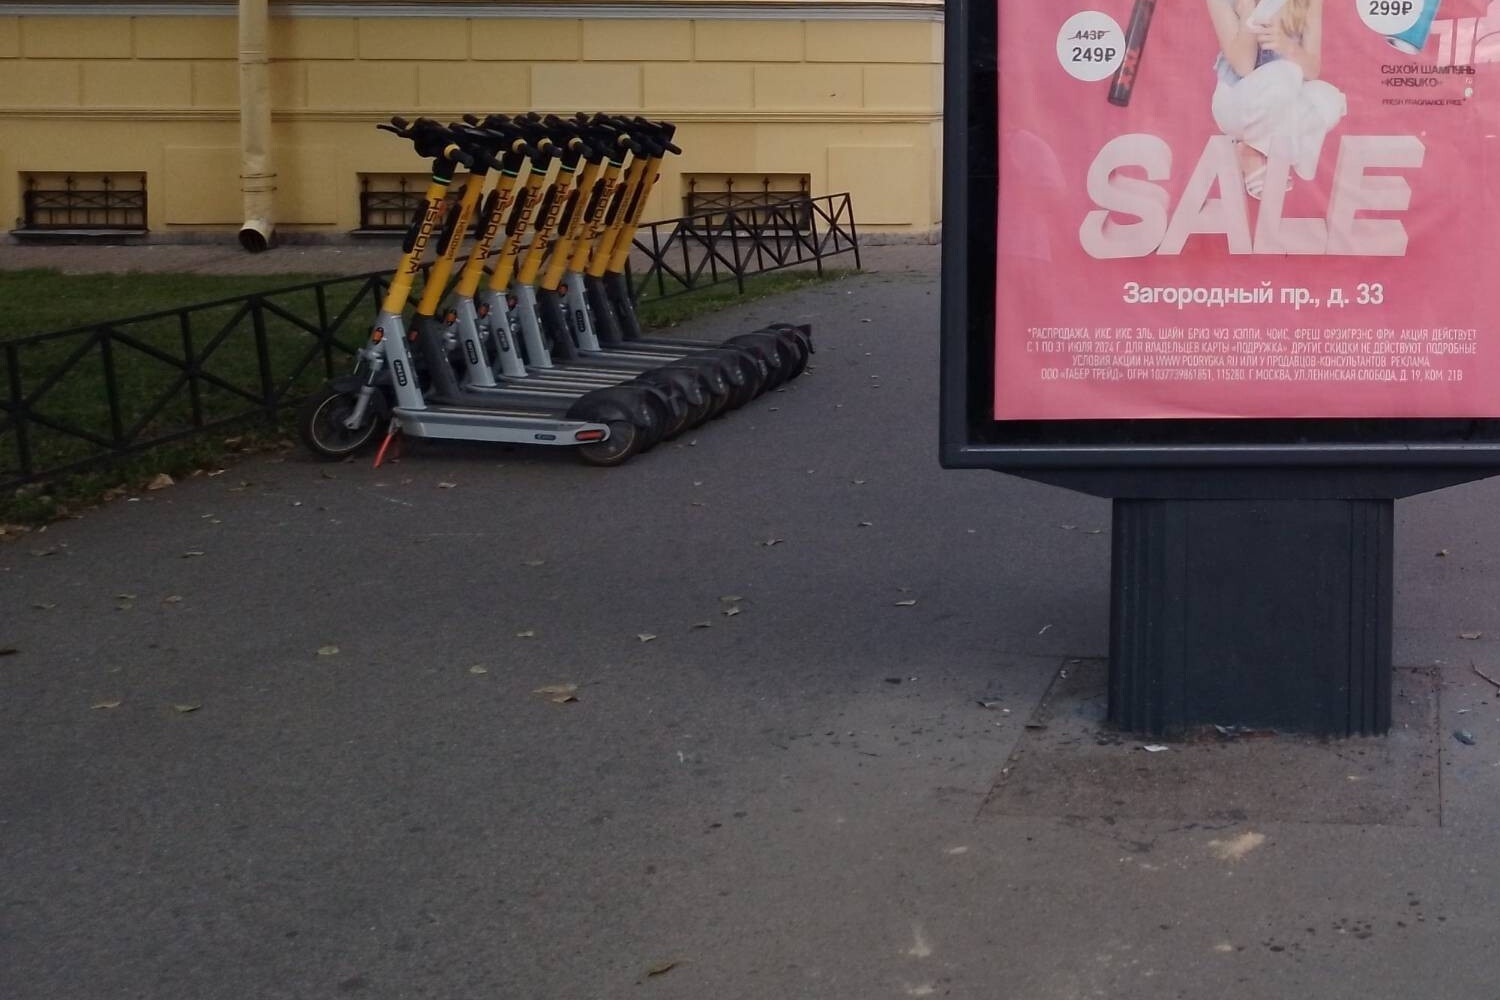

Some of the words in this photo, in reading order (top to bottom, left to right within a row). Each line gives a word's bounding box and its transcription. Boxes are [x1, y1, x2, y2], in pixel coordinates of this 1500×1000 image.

[1381, 62, 1419, 74] СУХОЙ
[1421, 65, 1476, 75] ШАМПУНЬ
[1079, 133, 1425, 259] SALE
[474, 188, 513, 261] WHOOSH
[506, 186, 543, 257] WHOOSH
[534, 183, 571, 251] WHOOSH
[404, 197, 443, 275] WHOOSH
[1122, 280, 1273, 309] Загородный
[1280, 285, 1320, 310] пр.,
[1327, 286, 1349, 306] д.
[1356, 283, 1384, 305] 33
[1041, 341, 1054, 353] ПО
[1068, 341, 1093, 353] ИЮЛЯ
[1125, 341, 1144, 353] ДЛЯ
[1145, 342, 1199, 354] ВЛАДЕЛЬЦЕВ
[1202, 342, 1230, 354] КАРТЫ
[1291, 342, 1322, 354] ДРУГИЕ
[1324, 342, 1358, 354] СКИДКИ
[1361, 343, 1371, 355] НЕ
[1426, 343, 1477, 355] ПОДРОБНЫЕ
[1158, 328, 1184, 340] ШАЙН
[1188, 328, 1210, 340] БРИЗ
[1213, 328, 1229, 340] ЧУЗ
[1400, 329, 1428, 341] АКЦИЯ
[1431, 329, 1478, 341] ДЕЙСТВУЕТ
[1041, 368, 1059, 380] ООО
[1127, 368, 1149, 380] ОГРН
[1072, 354, 1111, 366] УСЛОВИЯ
[1112, 354, 1142, 366] АКЦИИ
[1143, 355, 1154, 367] НА
[1240, 355, 1257, 367] ИЛИ
